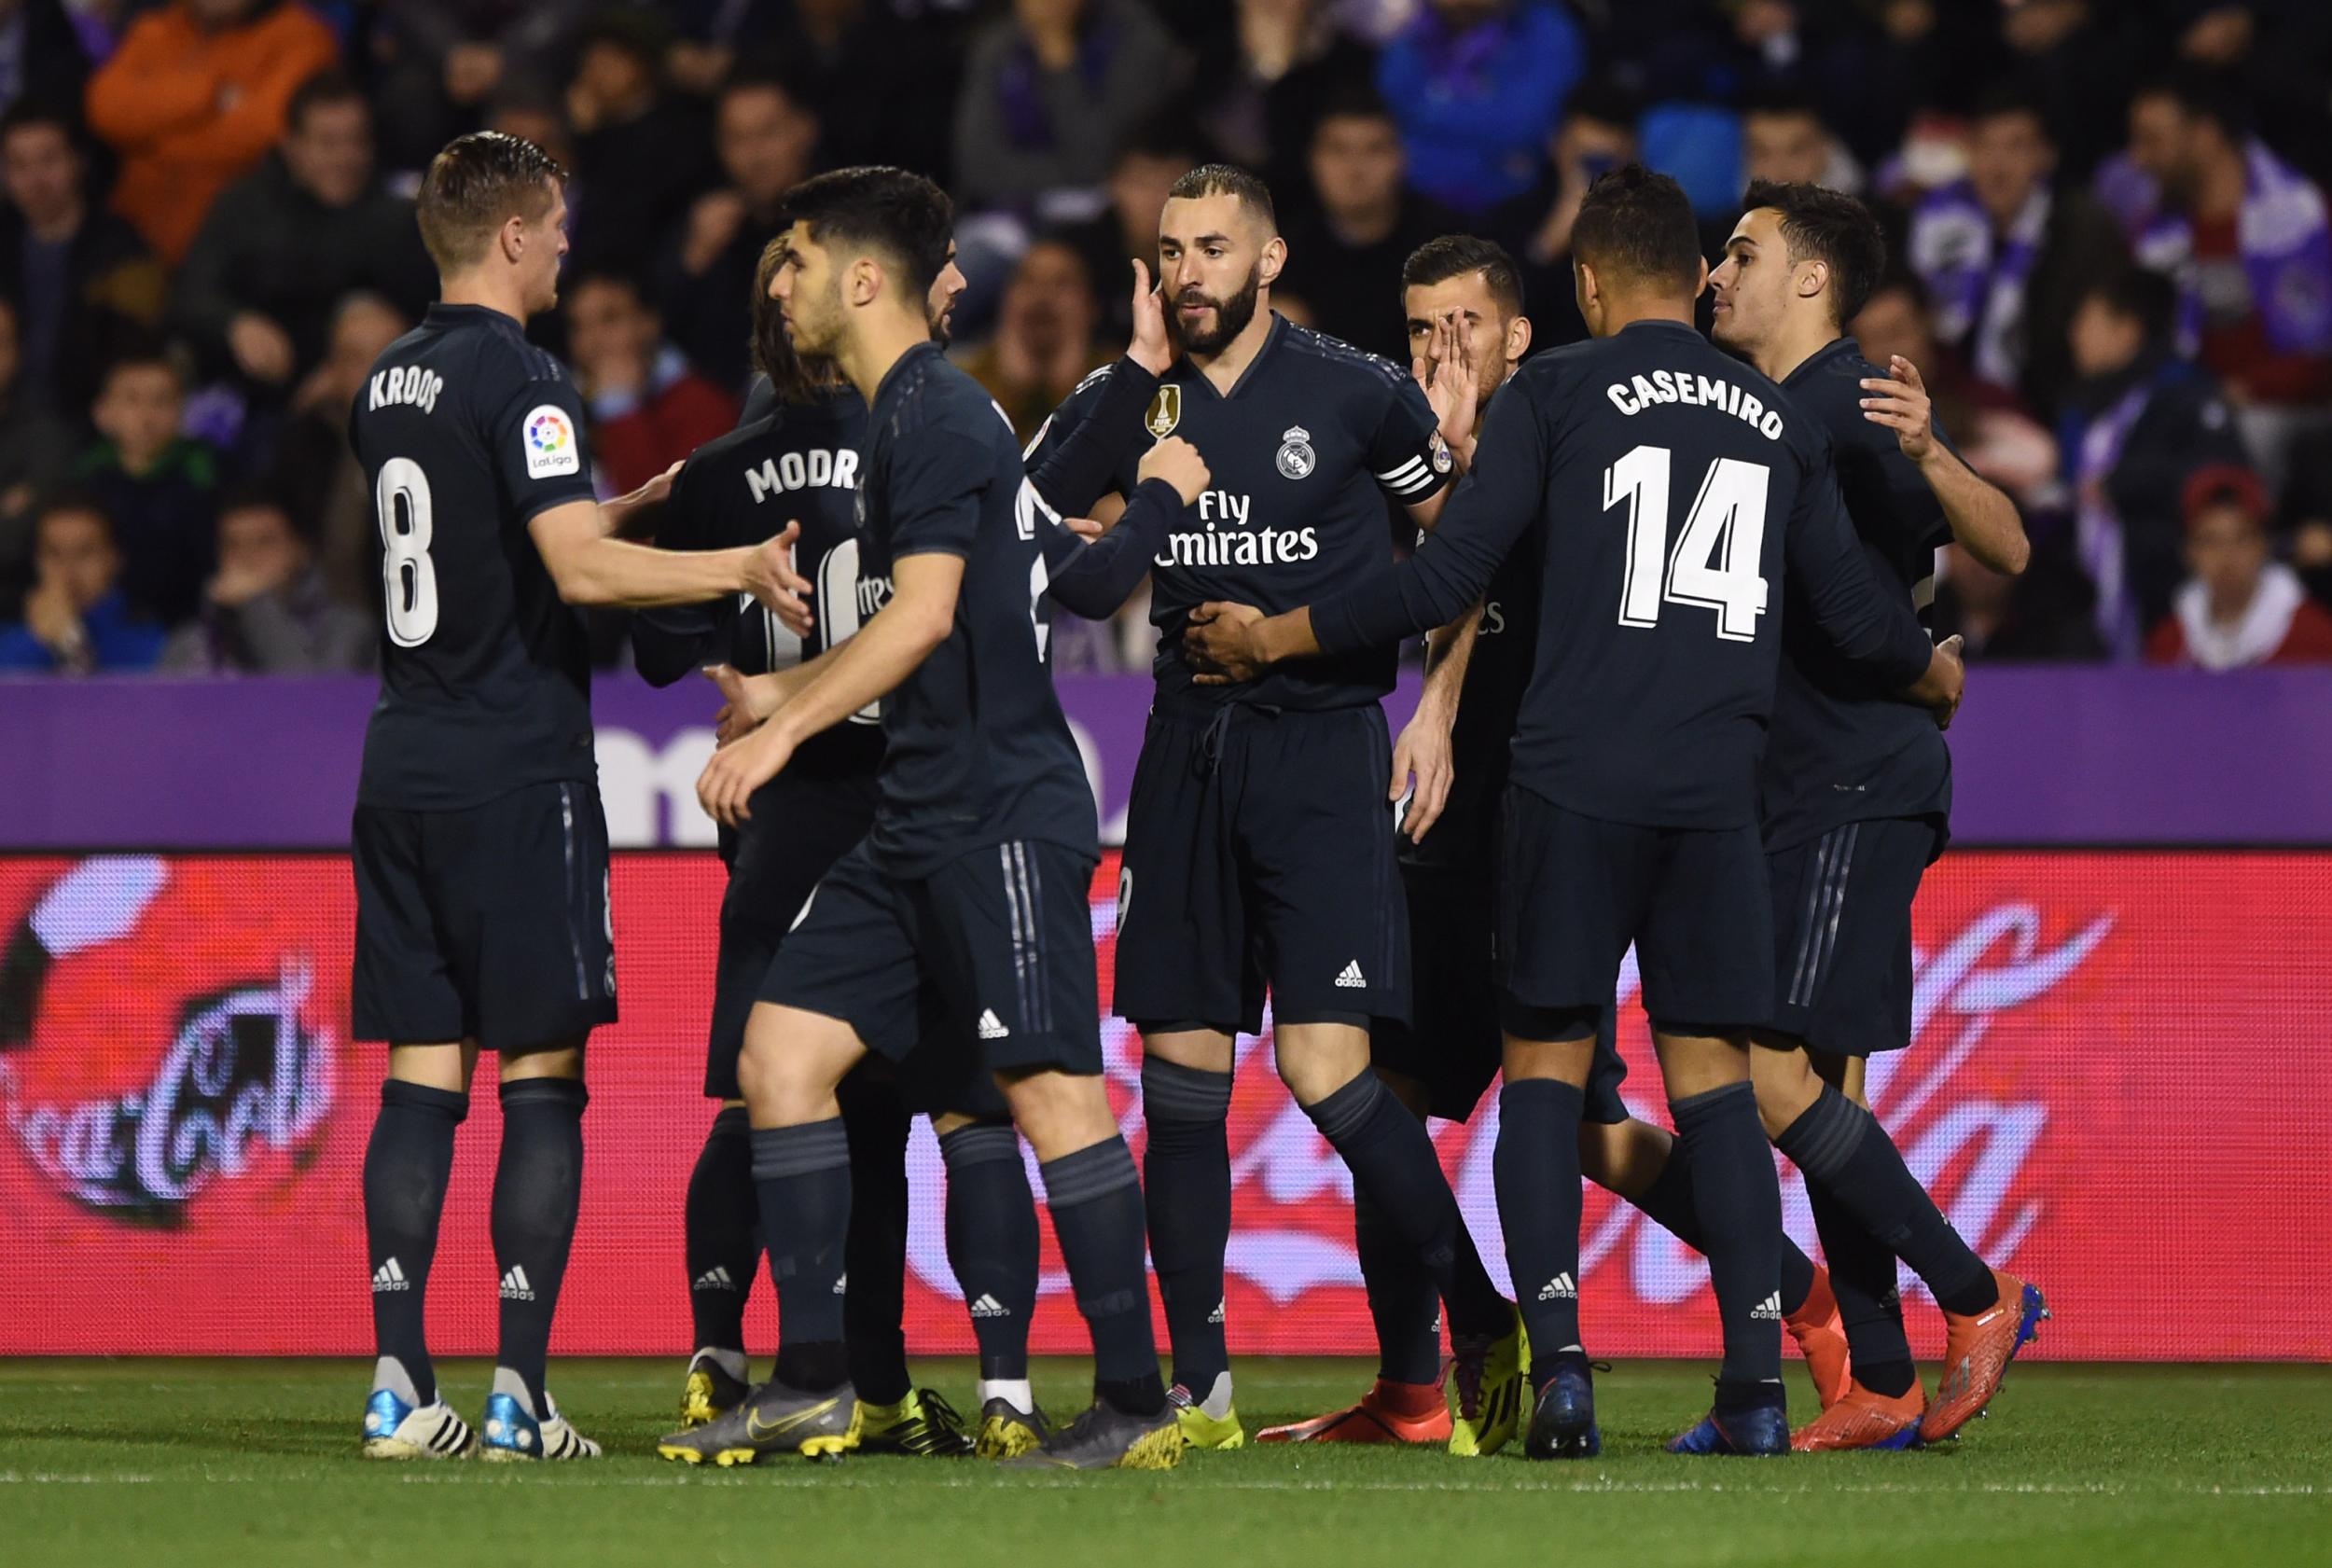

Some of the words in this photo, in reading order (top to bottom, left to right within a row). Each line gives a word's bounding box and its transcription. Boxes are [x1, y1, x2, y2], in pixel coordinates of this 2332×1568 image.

[369, 366, 443, 415] KROOS
[1606, 369, 1784, 440] CASEMIRO
[533, 455, 572, 468] LaLiga
[745, 448, 859, 504] MODR
[1199, 490, 1251, 525] Fly
[376, 456, 438, 648] 8
[1154, 521, 1319, 567] mirates
[1603, 444, 1770, 643] 14
[1334, 978, 1367, 988] adidas
